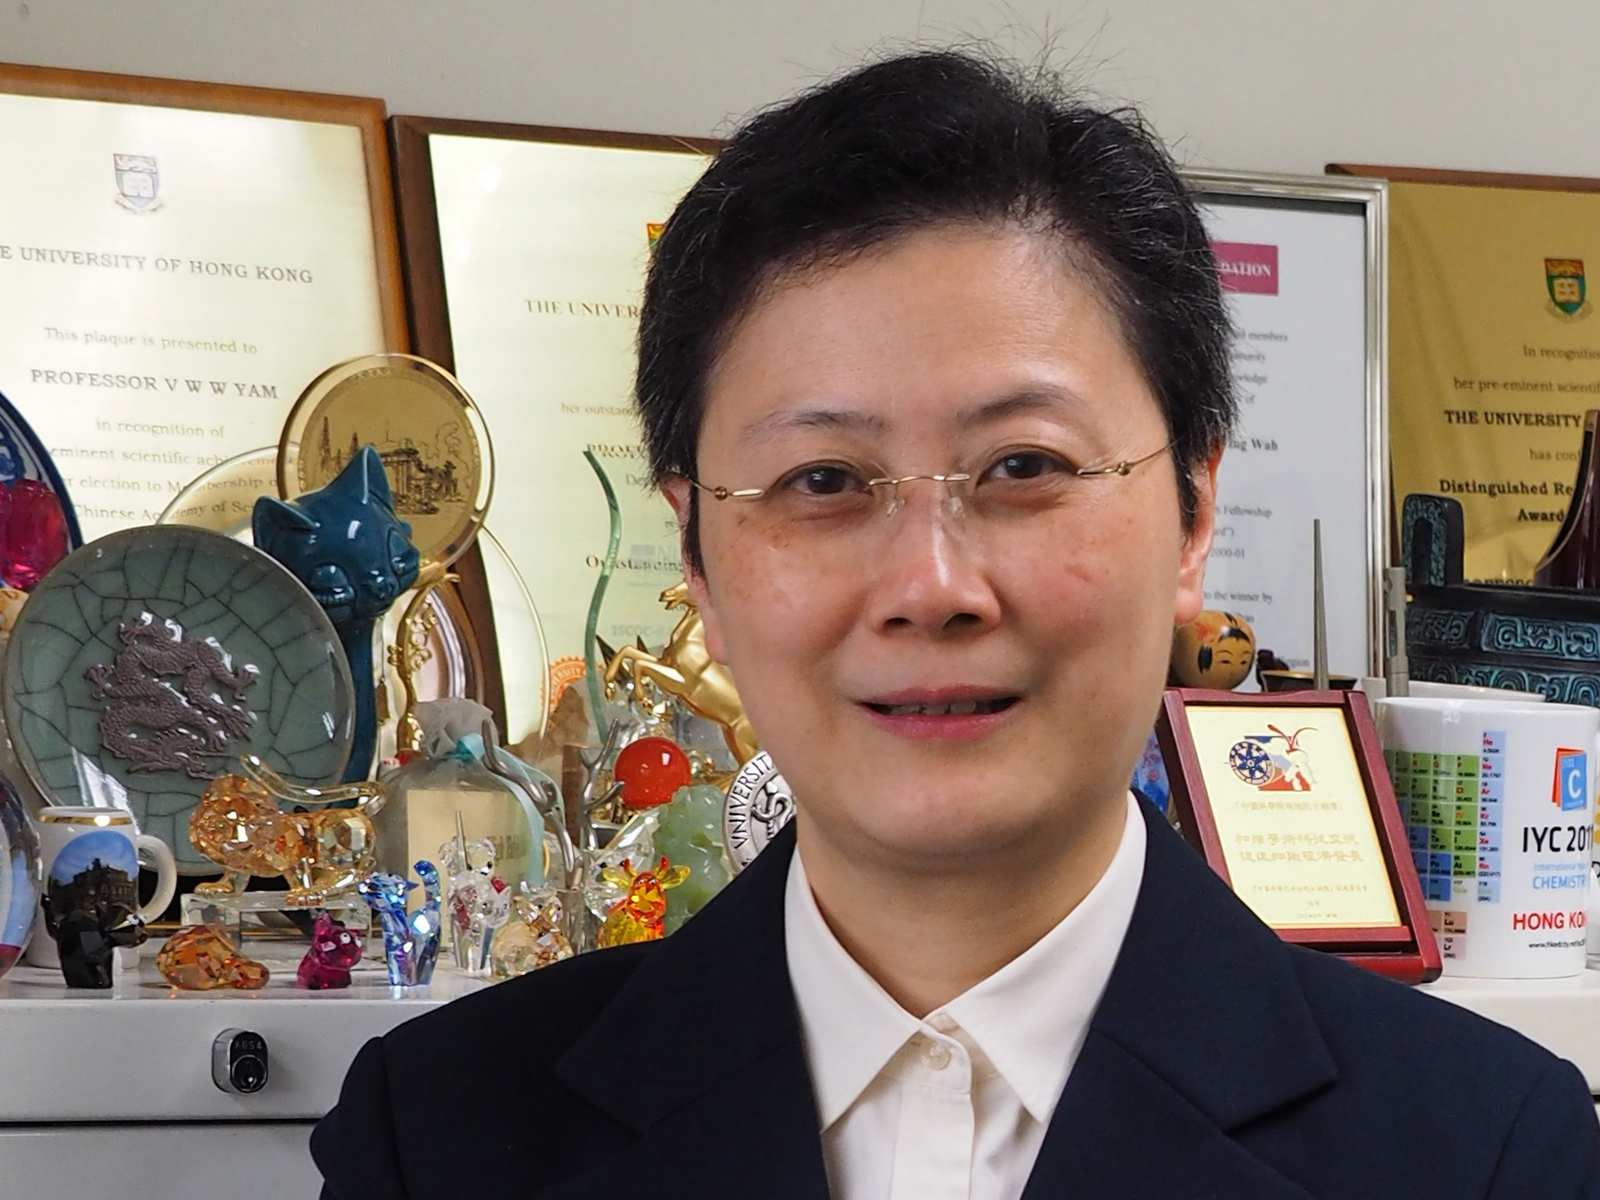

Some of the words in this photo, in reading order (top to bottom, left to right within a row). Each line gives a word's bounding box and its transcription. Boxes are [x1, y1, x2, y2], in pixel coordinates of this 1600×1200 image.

[20, 246, 147, 270] UNIVERSITY
[155, 257, 181, 271] OF
[189, 260, 249, 279] HONG
[255, 265, 314, 284] KONG
[524, 300, 563, 314] THE
[44, 327, 78, 342] This
[84, 331, 136, 347] plaque
[142, 334, 156, 347] is
[161, 336, 238, 354] presented
[243, 341, 258, 355] to
[1523, 344, 1536, 358] In
[30, 369, 158, 390] PROFESSOR
[164, 378, 178, 392] V
[185, 379, 202, 394] W
[209, 380, 227, 395] W
[234, 382, 280, 399] YAM
[1453, 376, 1474, 390] her
[1444, 409, 1479, 425] THE
[1484, 411, 1581, 428] UNIVERSITY
[97, 419, 111, 431] in
[118, 422, 205, 438] recognition
[210, 426, 226, 438] of
[1251, 438, 1278, 451] Wah
[122, 450, 191, 465] scientific
[1529, 448, 1552, 461] has
[80, 475, 141, 492] election
[147, 480, 161, 493] to
[168, 478, 264, 497] Mebership
[1439, 480, 1548, 497] Distinguished
[141, 503, 205, 521] Acdemy
[212, 502, 226, 515] of
[1568, 769, 1582, 799] C
[1523, 826, 1562, 852] IYC
[1513, 911, 1564, 930] HONG
